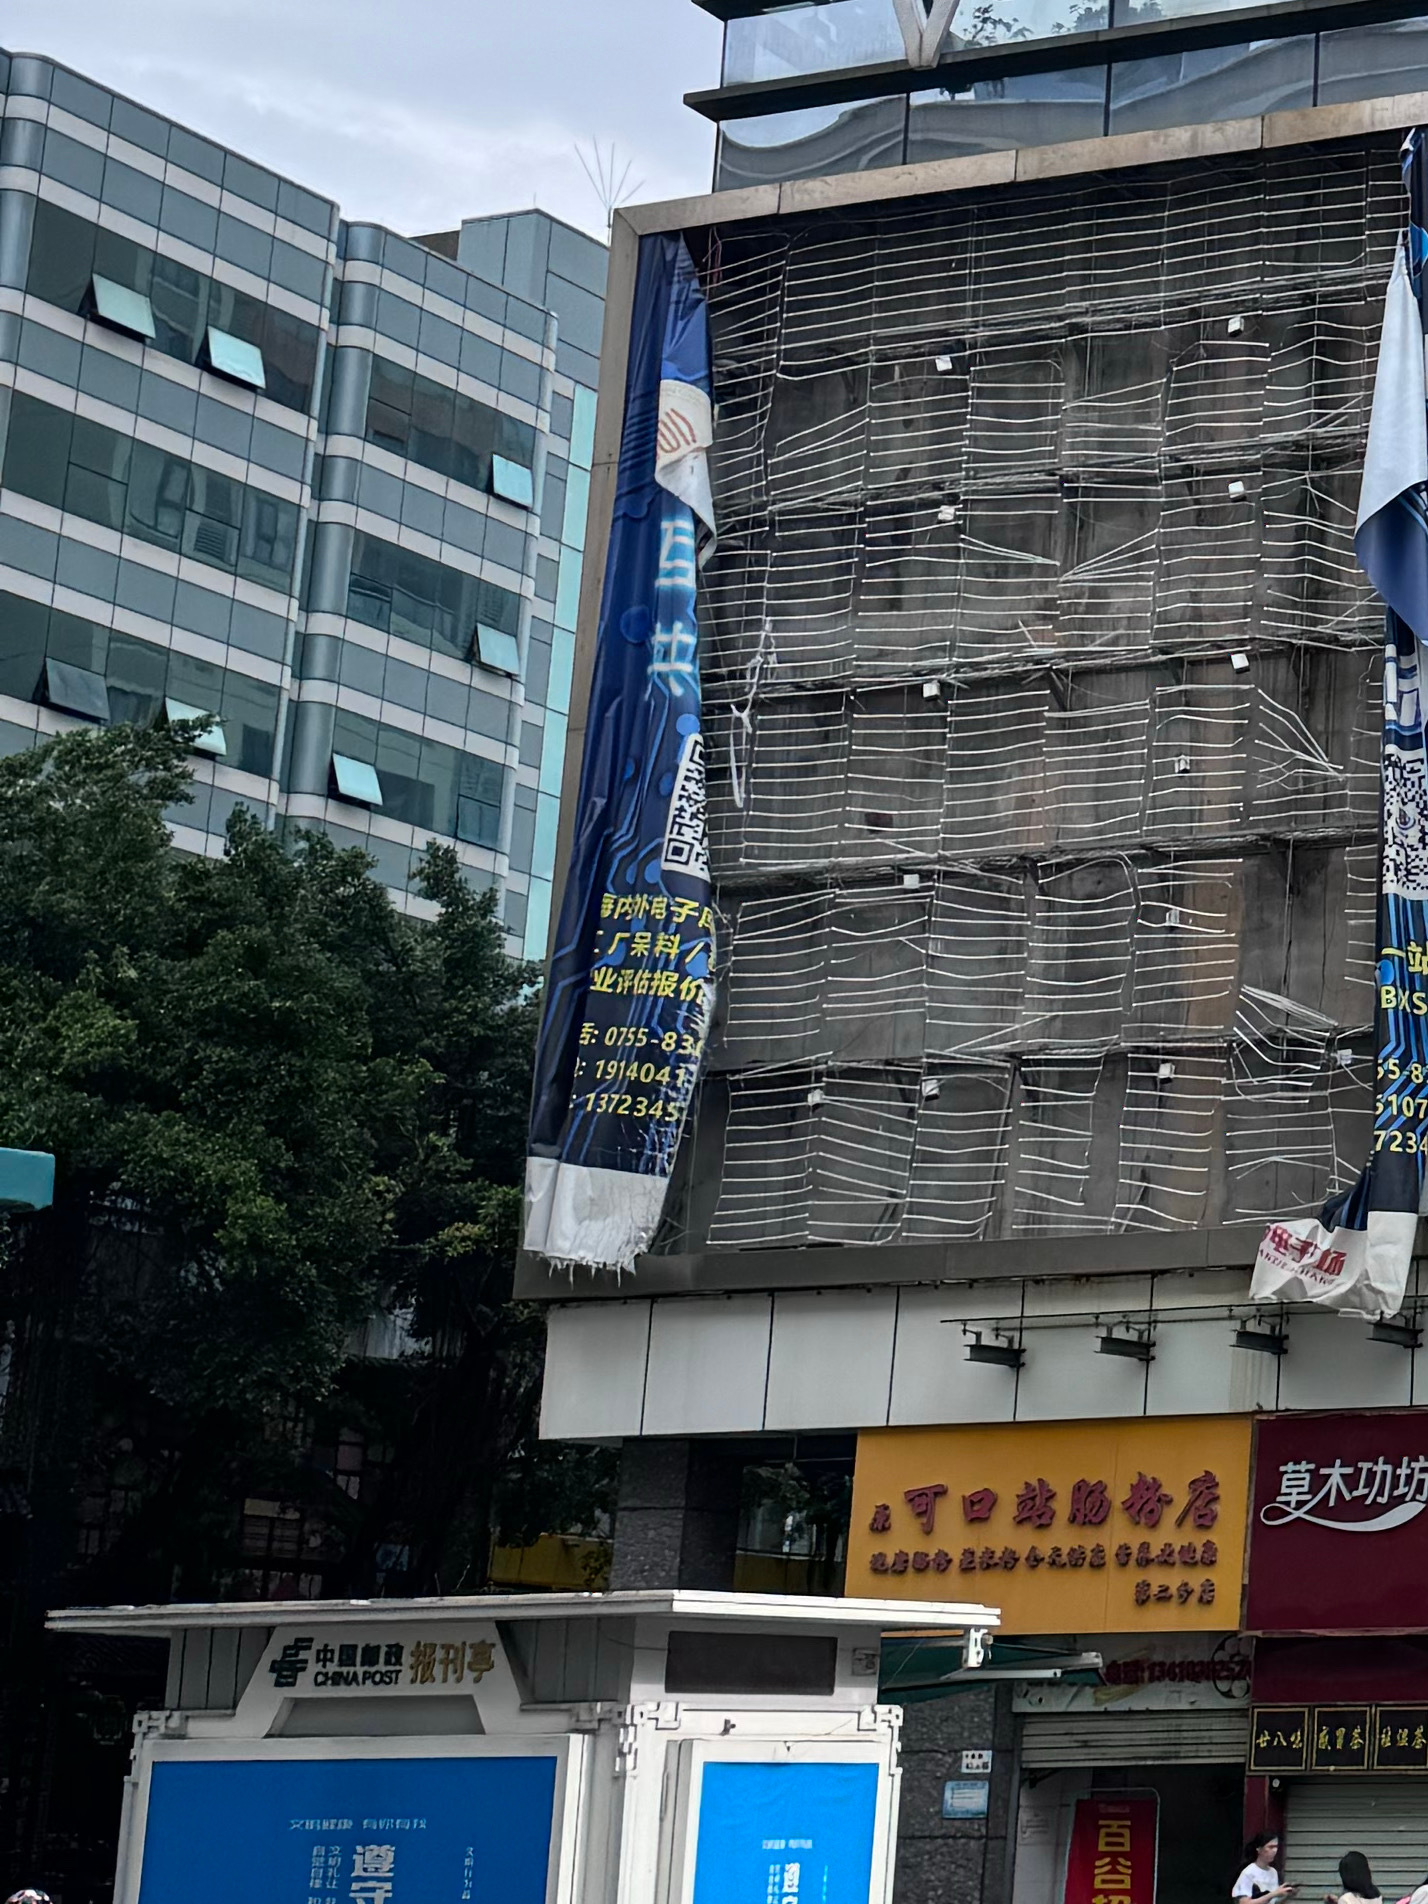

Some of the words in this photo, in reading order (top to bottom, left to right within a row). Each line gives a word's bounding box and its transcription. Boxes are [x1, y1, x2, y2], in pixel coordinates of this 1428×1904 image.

[313, 1671, 360, 1687] CHINA
[361, 1669, 403, 1686] POST
[314, 1642, 405, 1669] 中国邮政
[409, 1637, 497, 1686] 报刊亭
